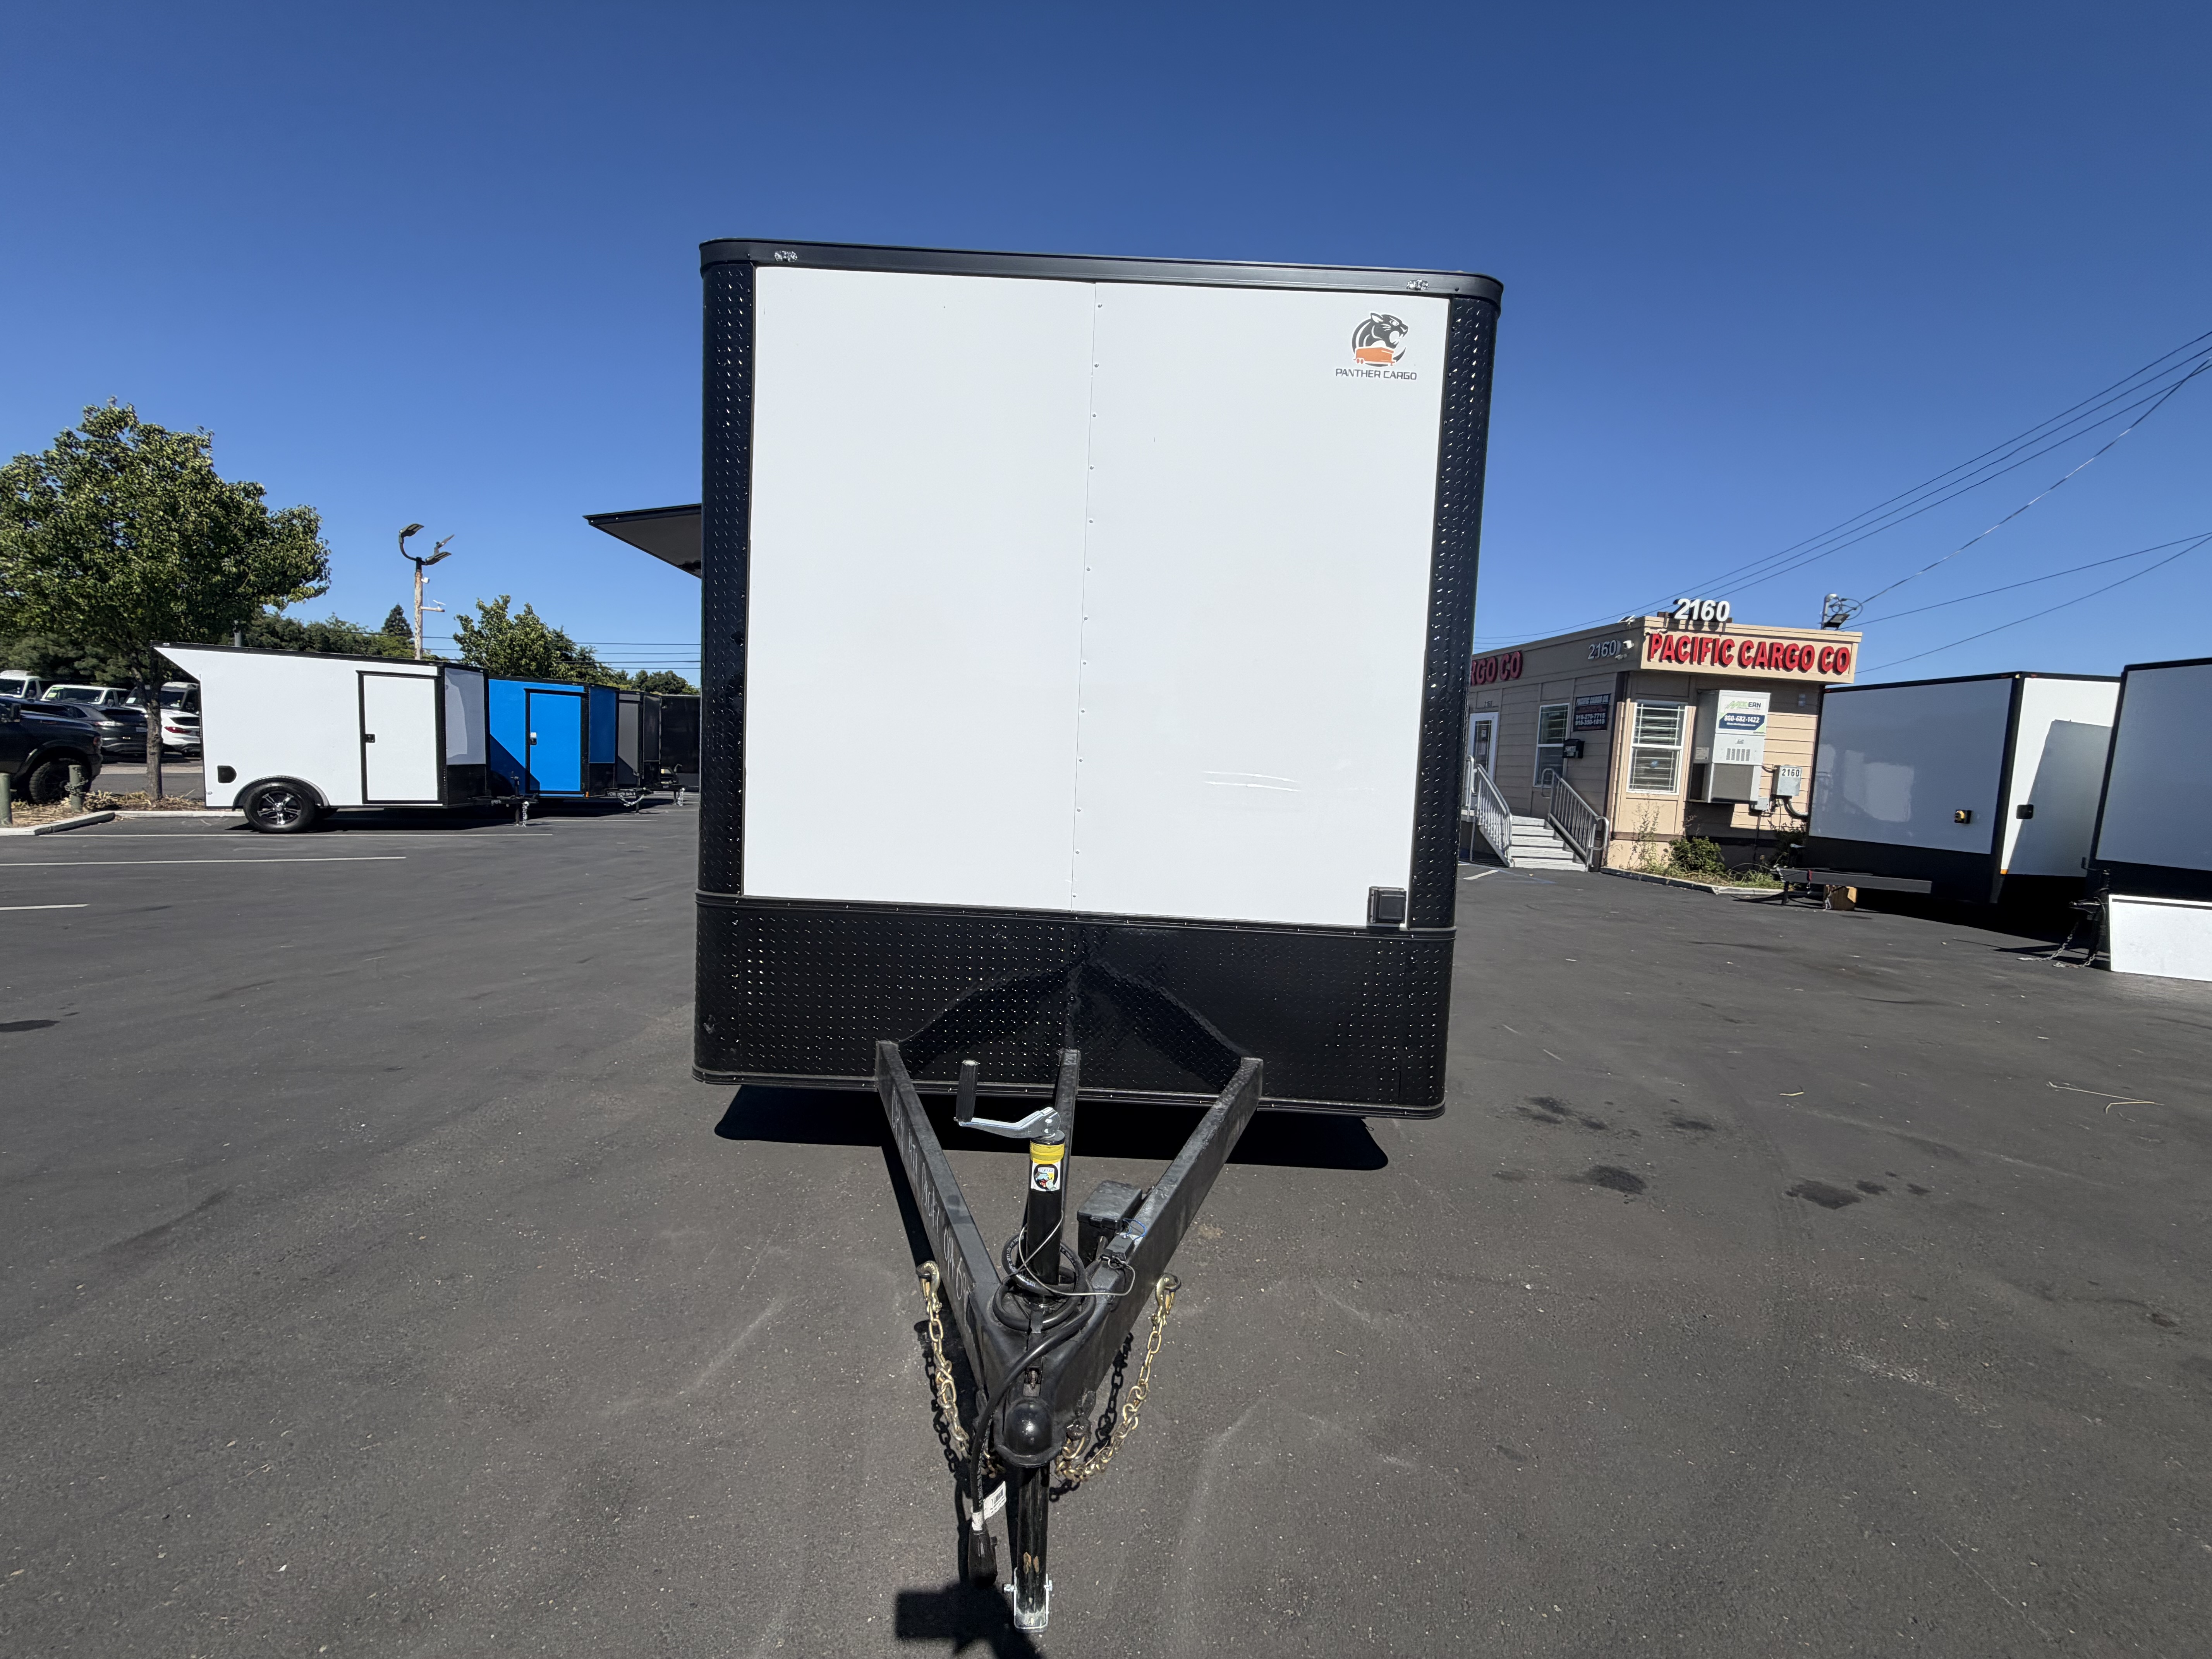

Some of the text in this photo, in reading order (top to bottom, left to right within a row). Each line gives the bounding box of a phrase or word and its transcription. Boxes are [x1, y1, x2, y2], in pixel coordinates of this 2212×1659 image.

[1336, 368, 1417, 380] PANTHER CARGO
[1674, 598, 1730, 622] 2160
[1588, 640, 1619, 659] 2160
[1649, 634, 1850, 673] PACIFIC CARGO CO
[1500, 651, 1522, 681] CO
[1782, 768, 1800, 777] 2160
